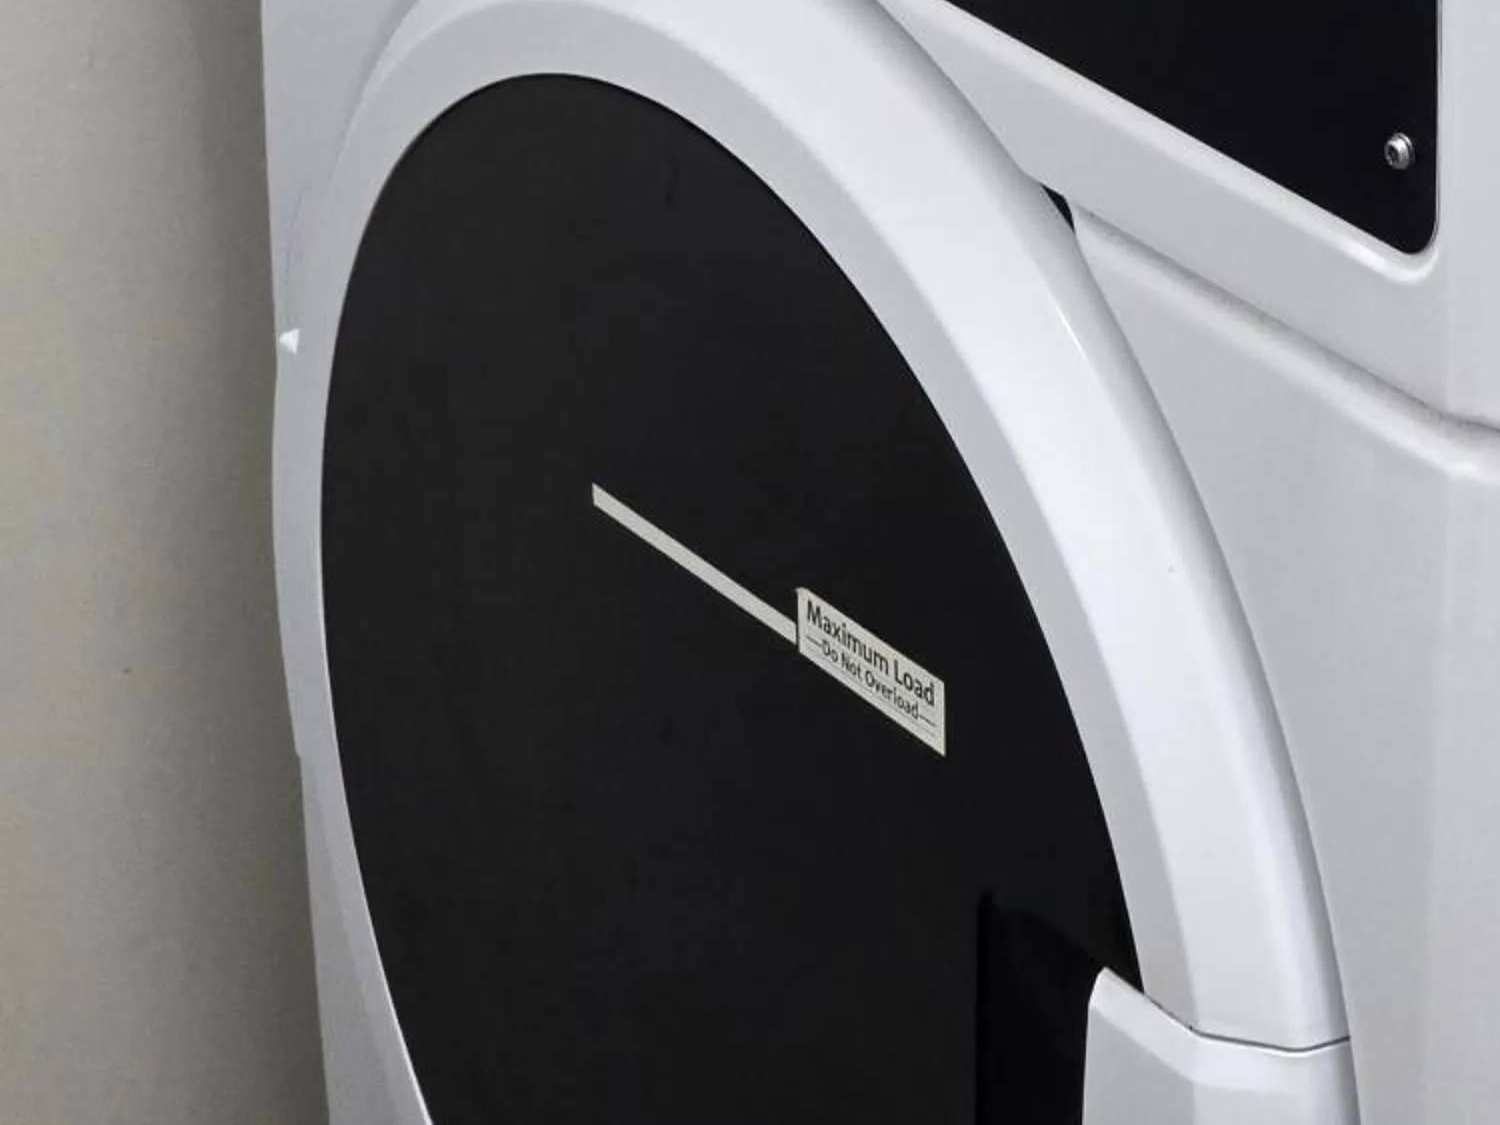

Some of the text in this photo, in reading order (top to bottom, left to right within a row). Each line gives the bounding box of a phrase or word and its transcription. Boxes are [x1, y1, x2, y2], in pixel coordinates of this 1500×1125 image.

[807, 600, 935, 707] Maximum Load
[821, 639, 919, 720] Do Not Overload
